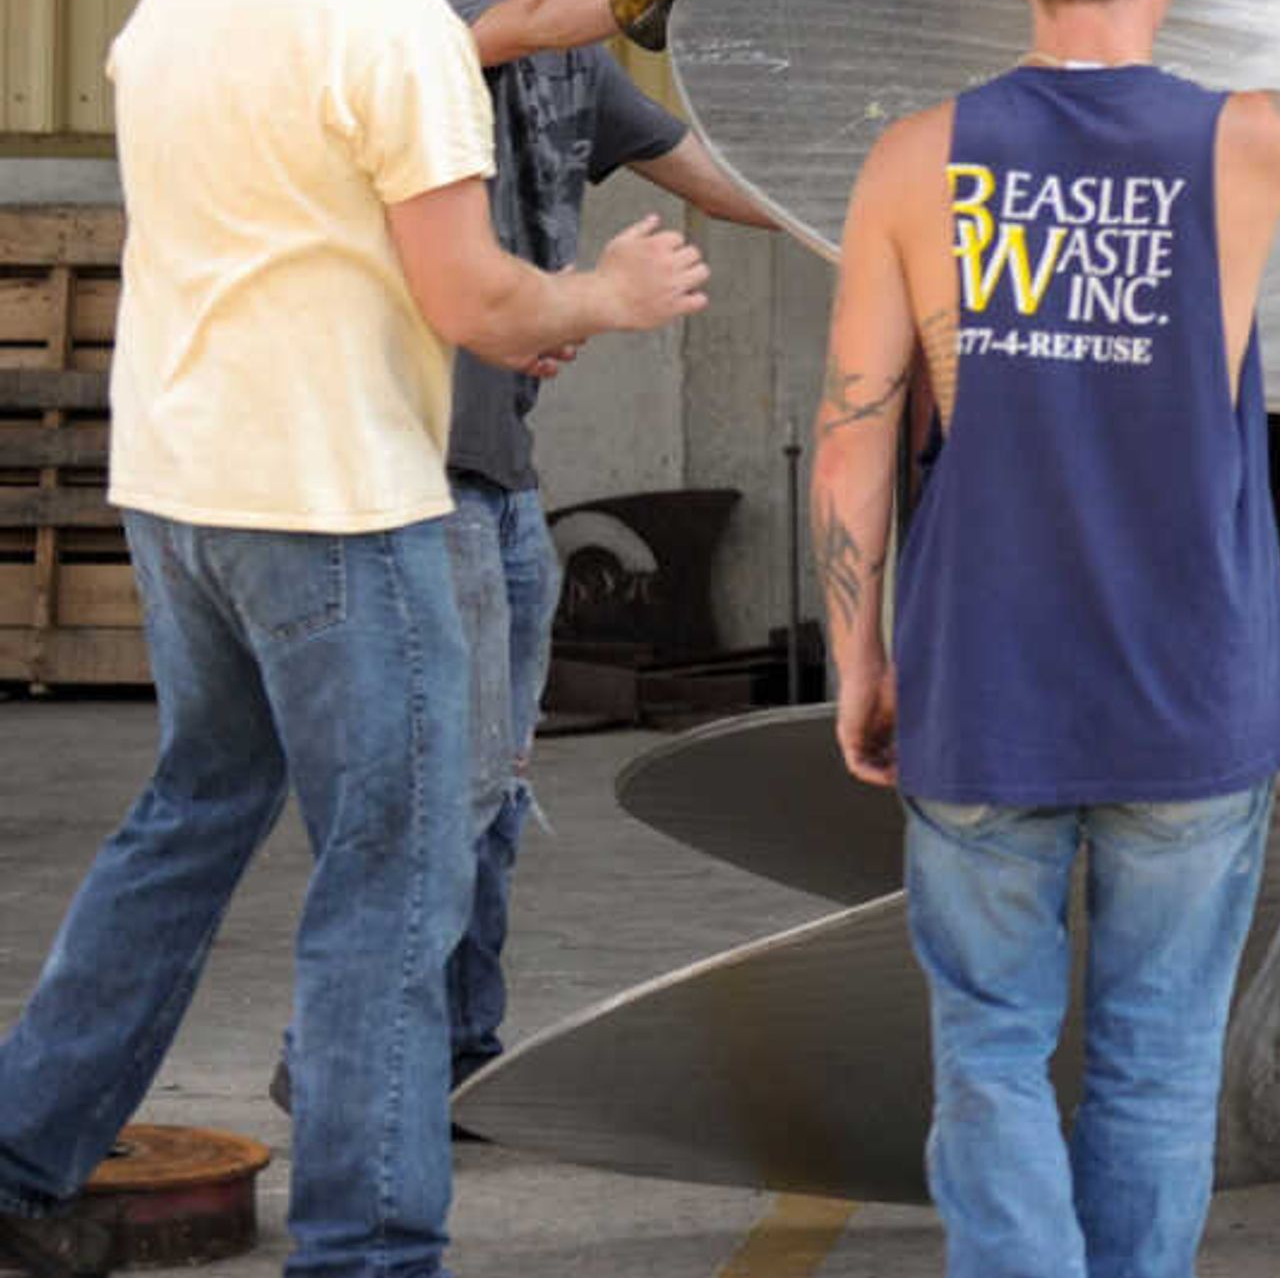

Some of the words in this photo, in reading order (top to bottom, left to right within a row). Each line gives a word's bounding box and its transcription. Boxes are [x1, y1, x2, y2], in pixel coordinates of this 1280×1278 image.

[946, 163, 1186, 257] BEASLEY
[957, 218, 1173, 315] WASTE
[1067, 274, 1169, 325] INC.
